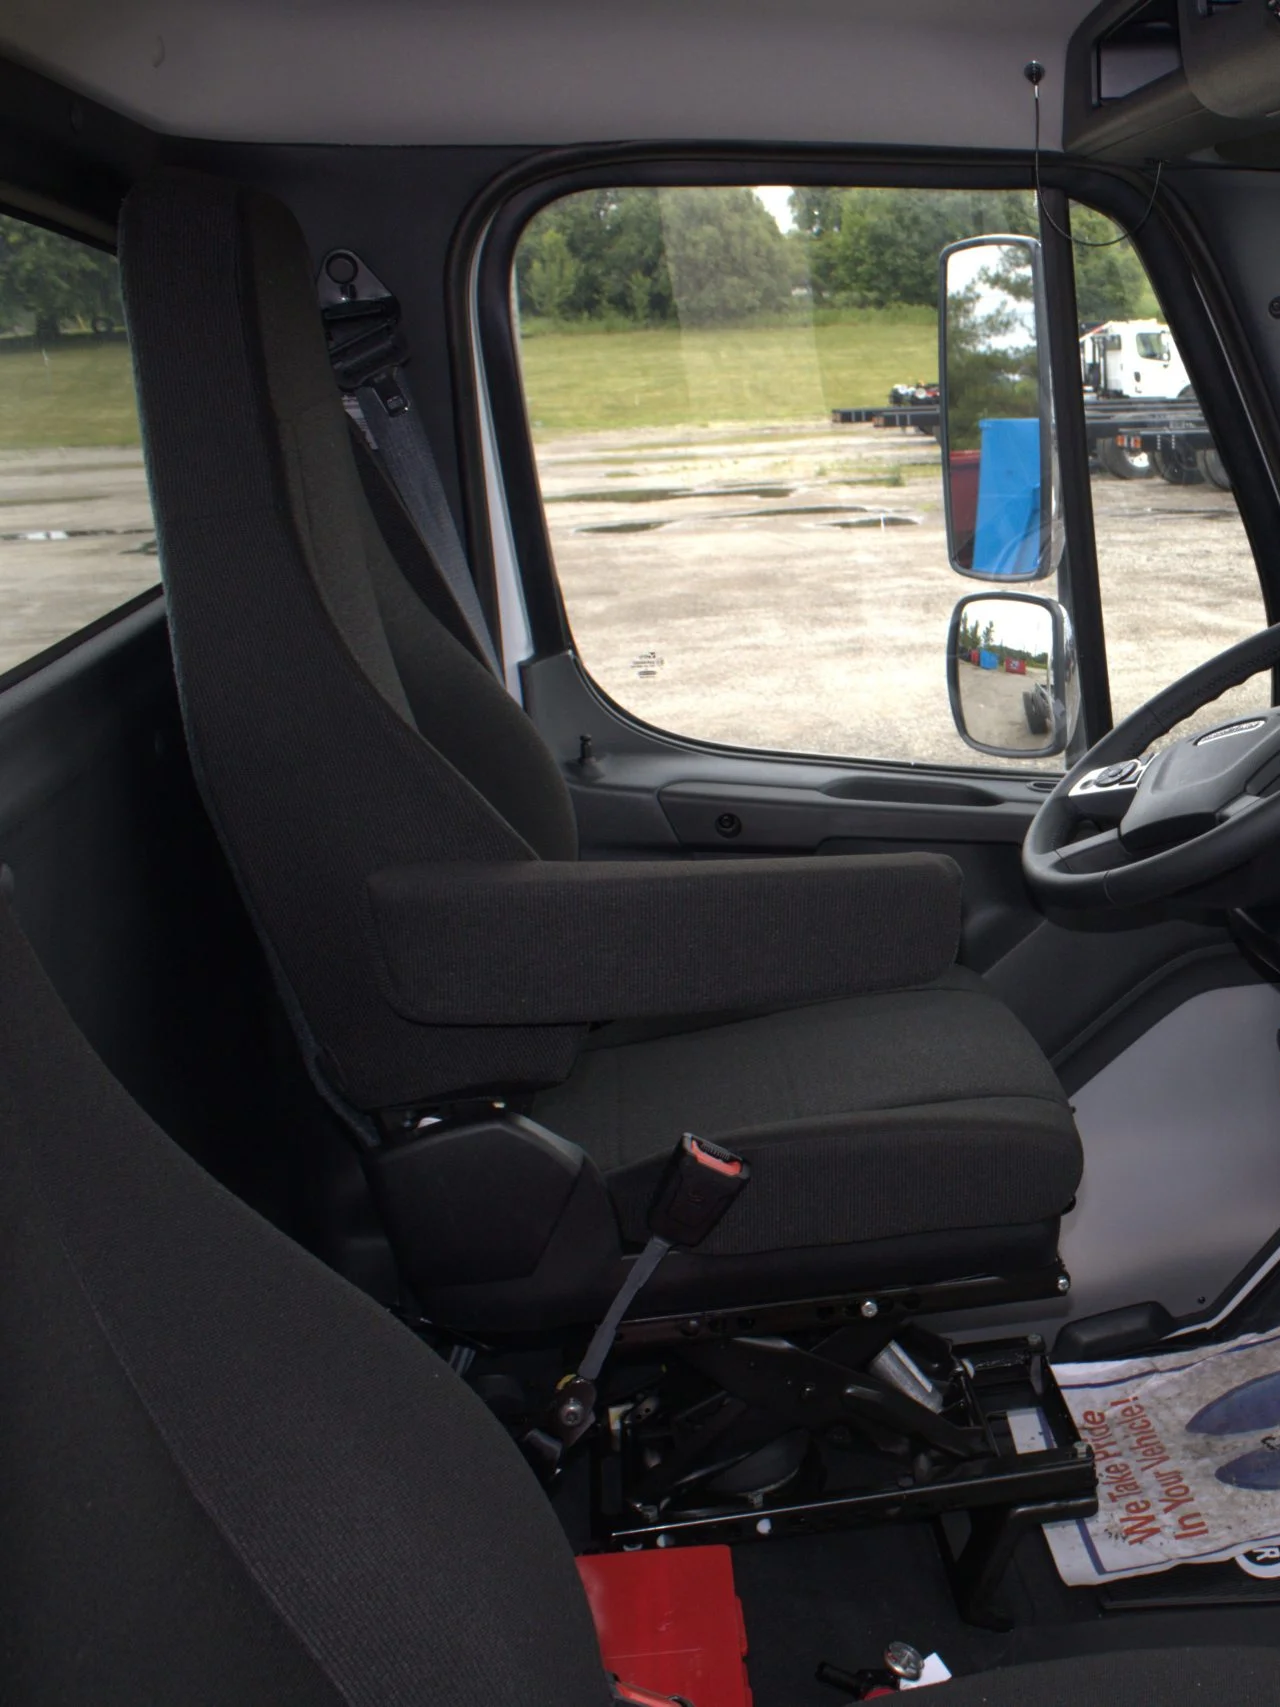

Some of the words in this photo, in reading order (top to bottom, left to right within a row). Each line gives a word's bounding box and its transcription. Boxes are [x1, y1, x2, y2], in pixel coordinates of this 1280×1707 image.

[1079, 1409, 1123, 1462] Pride
[1111, 1396, 1170, 1472] Vehicle!
[1102, 1463, 1143, 1503] Take
[1153, 1469, 1194, 1514] Your
[1119, 1500, 1161, 1545] We
[1174, 1512, 1209, 1540] In
